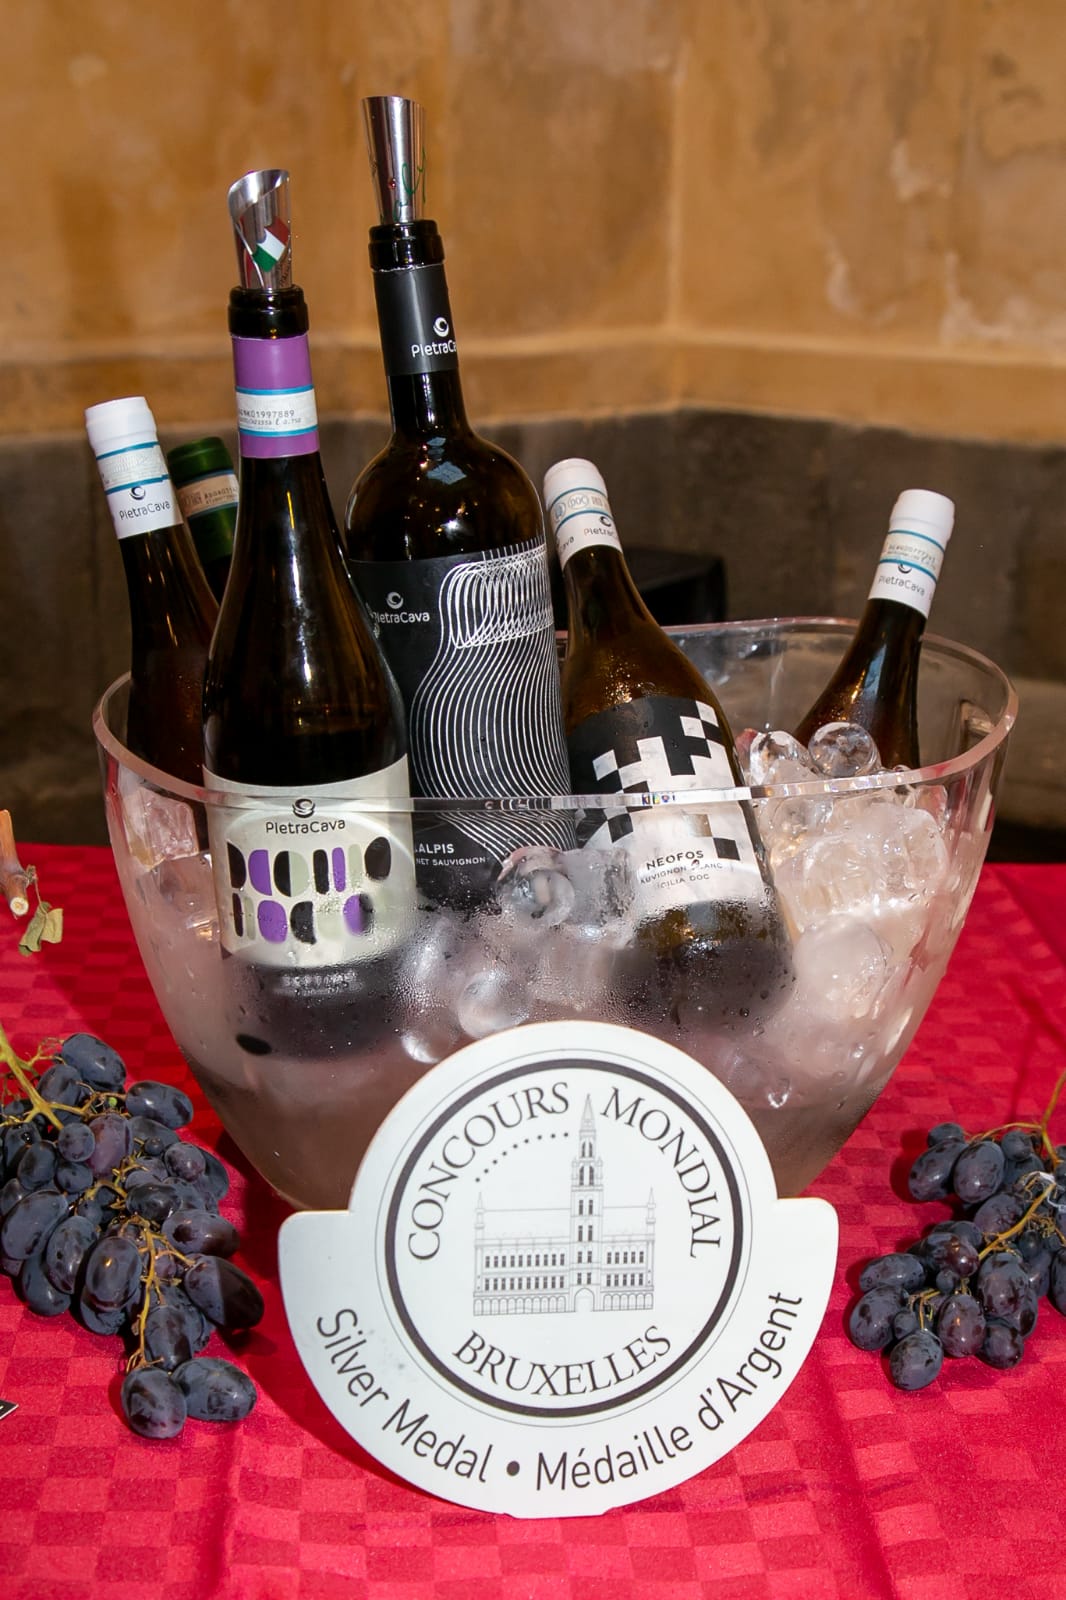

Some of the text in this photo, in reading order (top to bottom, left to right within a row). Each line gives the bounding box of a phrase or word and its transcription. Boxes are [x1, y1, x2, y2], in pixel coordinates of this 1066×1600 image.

[119, 500, 171, 520] PietraCava
[878, 575, 926, 597] PietraCava
[265, 819, 346, 834] PietraCava
[432, 856, 486, 866] SAUVIGNON
[646, 850, 704, 870] NEOFOS
[689, 873, 710, 882] DOC
[408, 1081, 722, 1261] CONCOURS MONDIAL
[452, 1325, 673, 1397] BRUXELLES
[316, 1291, 803, 1492] Silver Medal Médaille d'Argent
